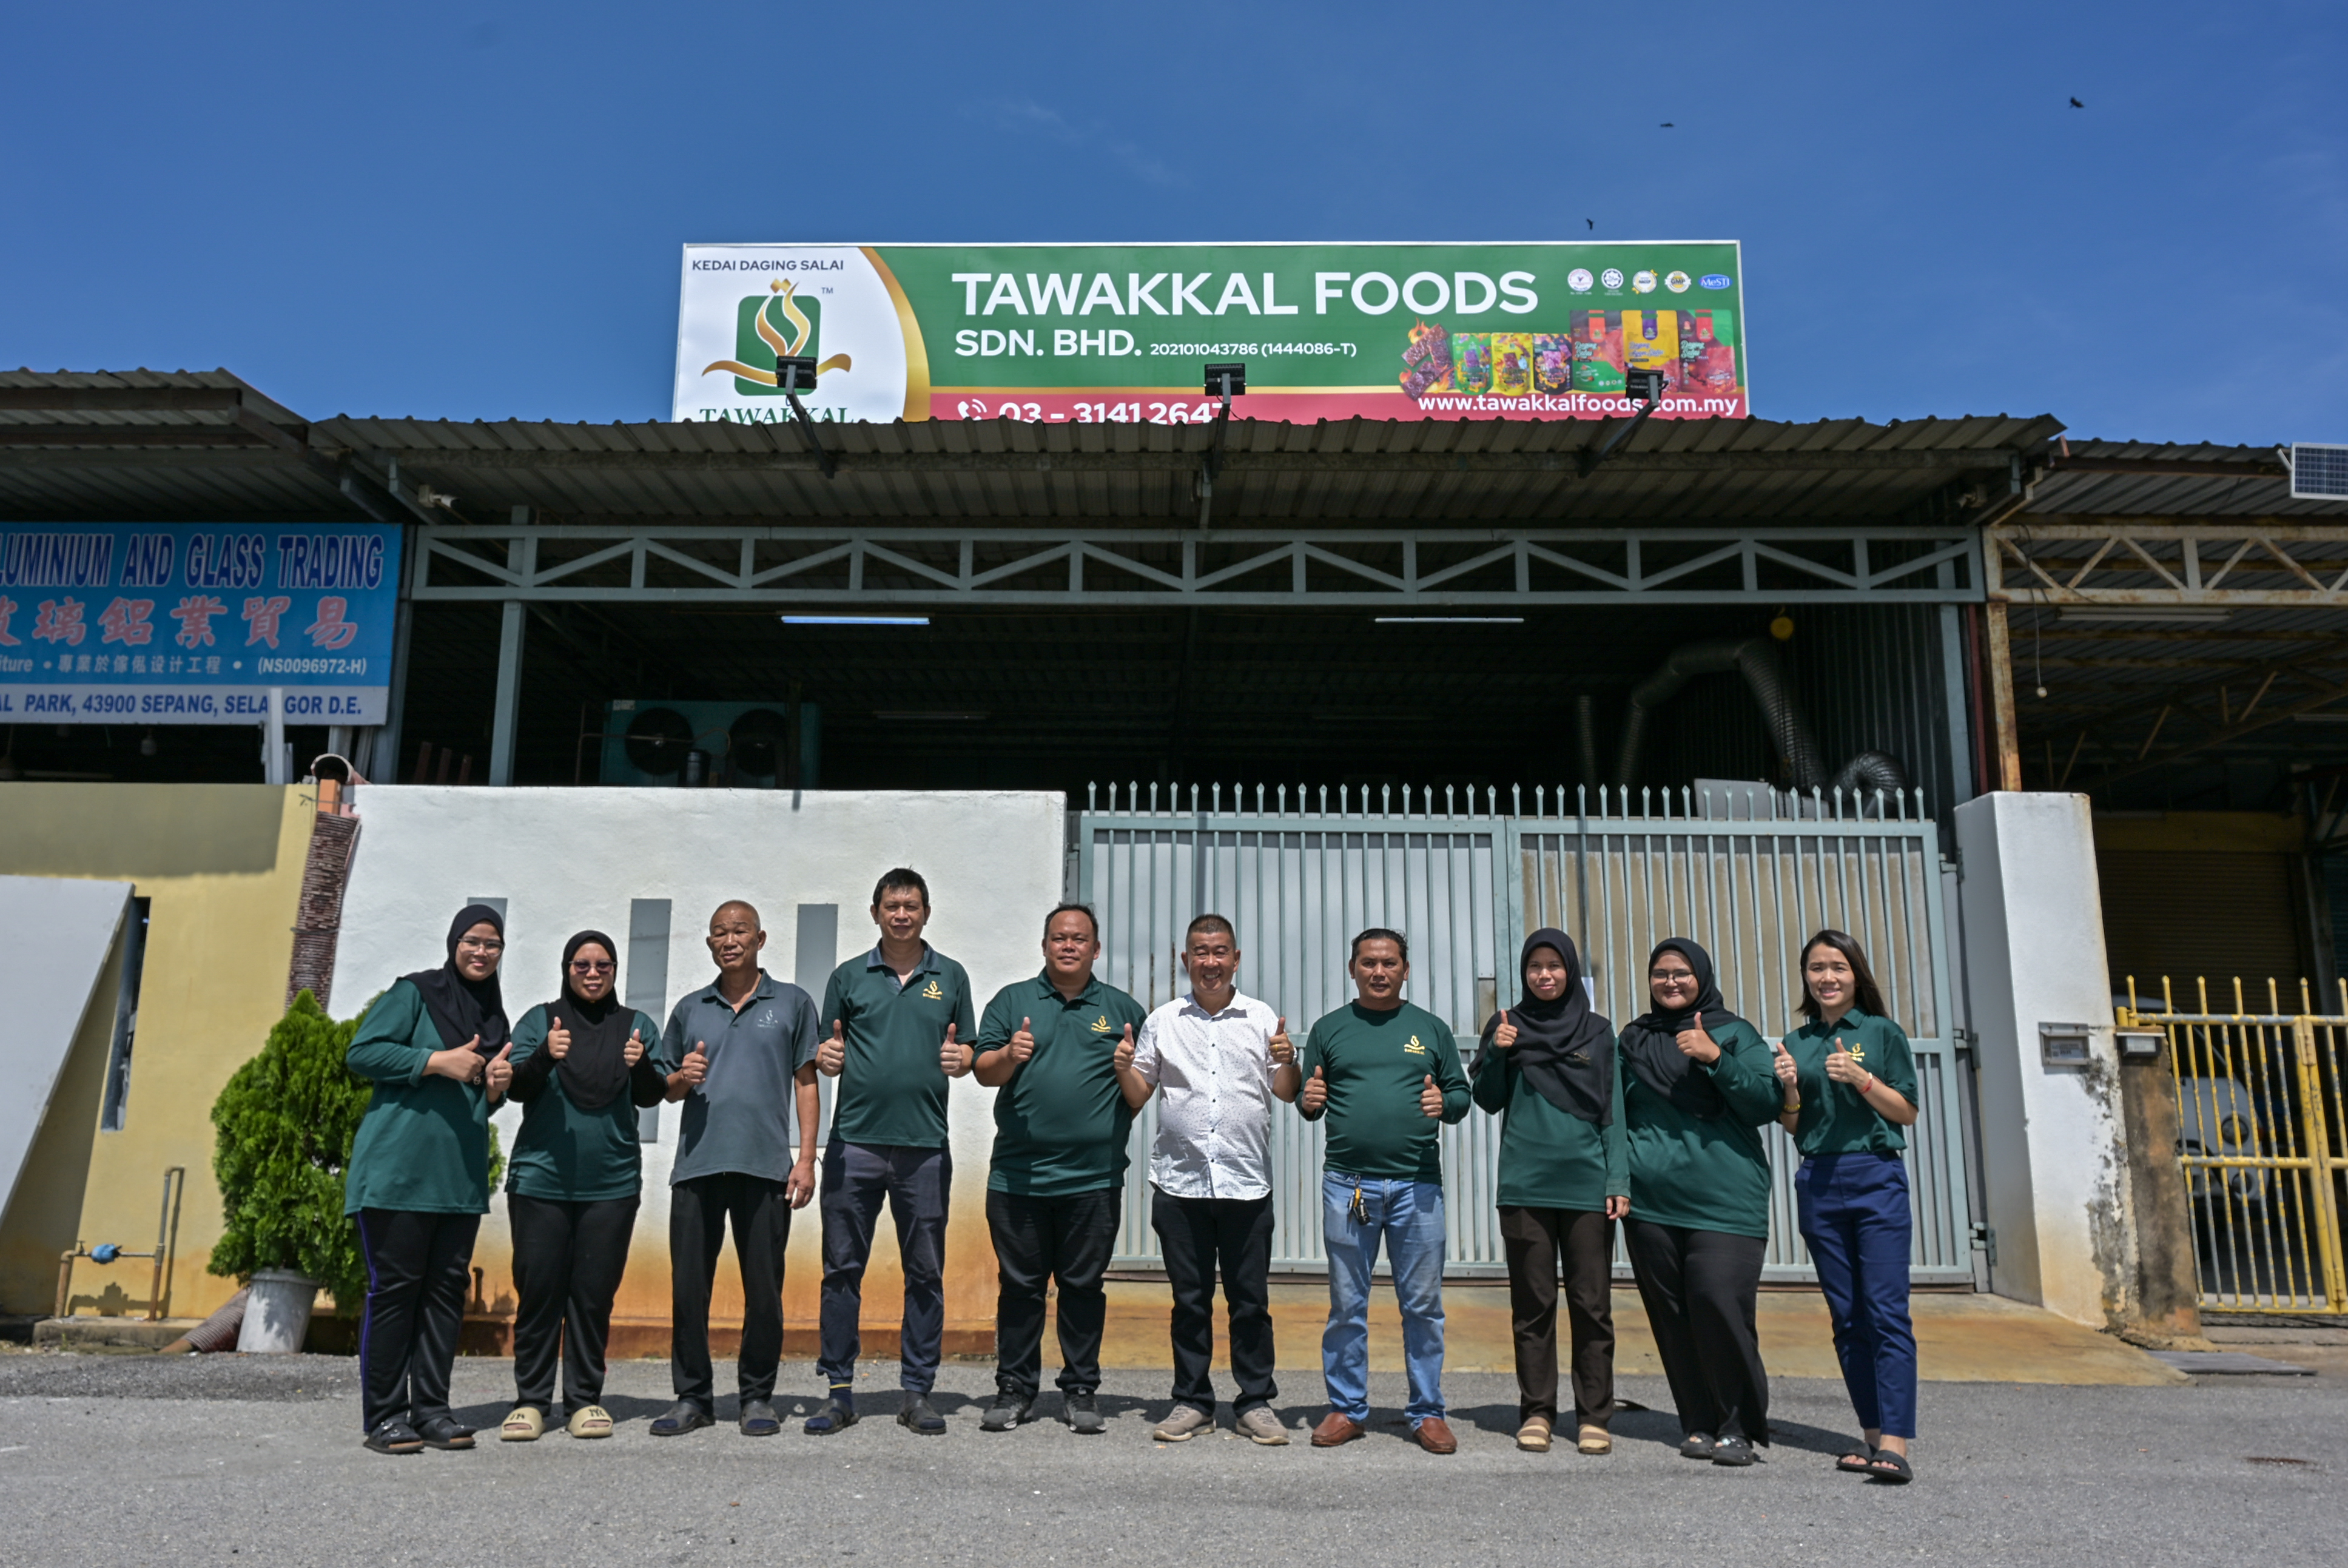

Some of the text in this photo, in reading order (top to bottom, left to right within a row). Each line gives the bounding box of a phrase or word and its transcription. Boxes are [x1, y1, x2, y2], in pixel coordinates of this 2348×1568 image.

[692, 260, 844, 271] KEDAI DAGING SALAI
[952, 272, 1298, 315] TAWAKKAL
[1315, 271, 1538, 315] FOODS
[955, 329, 1357, 357] SDN. BHD. 202101043786 (1444086-T)
[1000, 402, 1041, 423] 03
[1073, 403, 1140, 423] 3141
[1418, 394, 1738, 416] www.tawakkalfoodsom.my
[119, 534, 175, 587] AND
[186, 534, 265, 588] GLASS
[277, 534, 383, 589] TRADING
[258, 657, 367, 676] (NS0096972-H)
[24, 693, 76, 716] PARK,
[82, 694, 136, 713] 43900
[141, 694, 218, 717] SEPANG,
[224, 695, 322, 715] SELAGOR
[328, 696, 362, 715] D.E.
